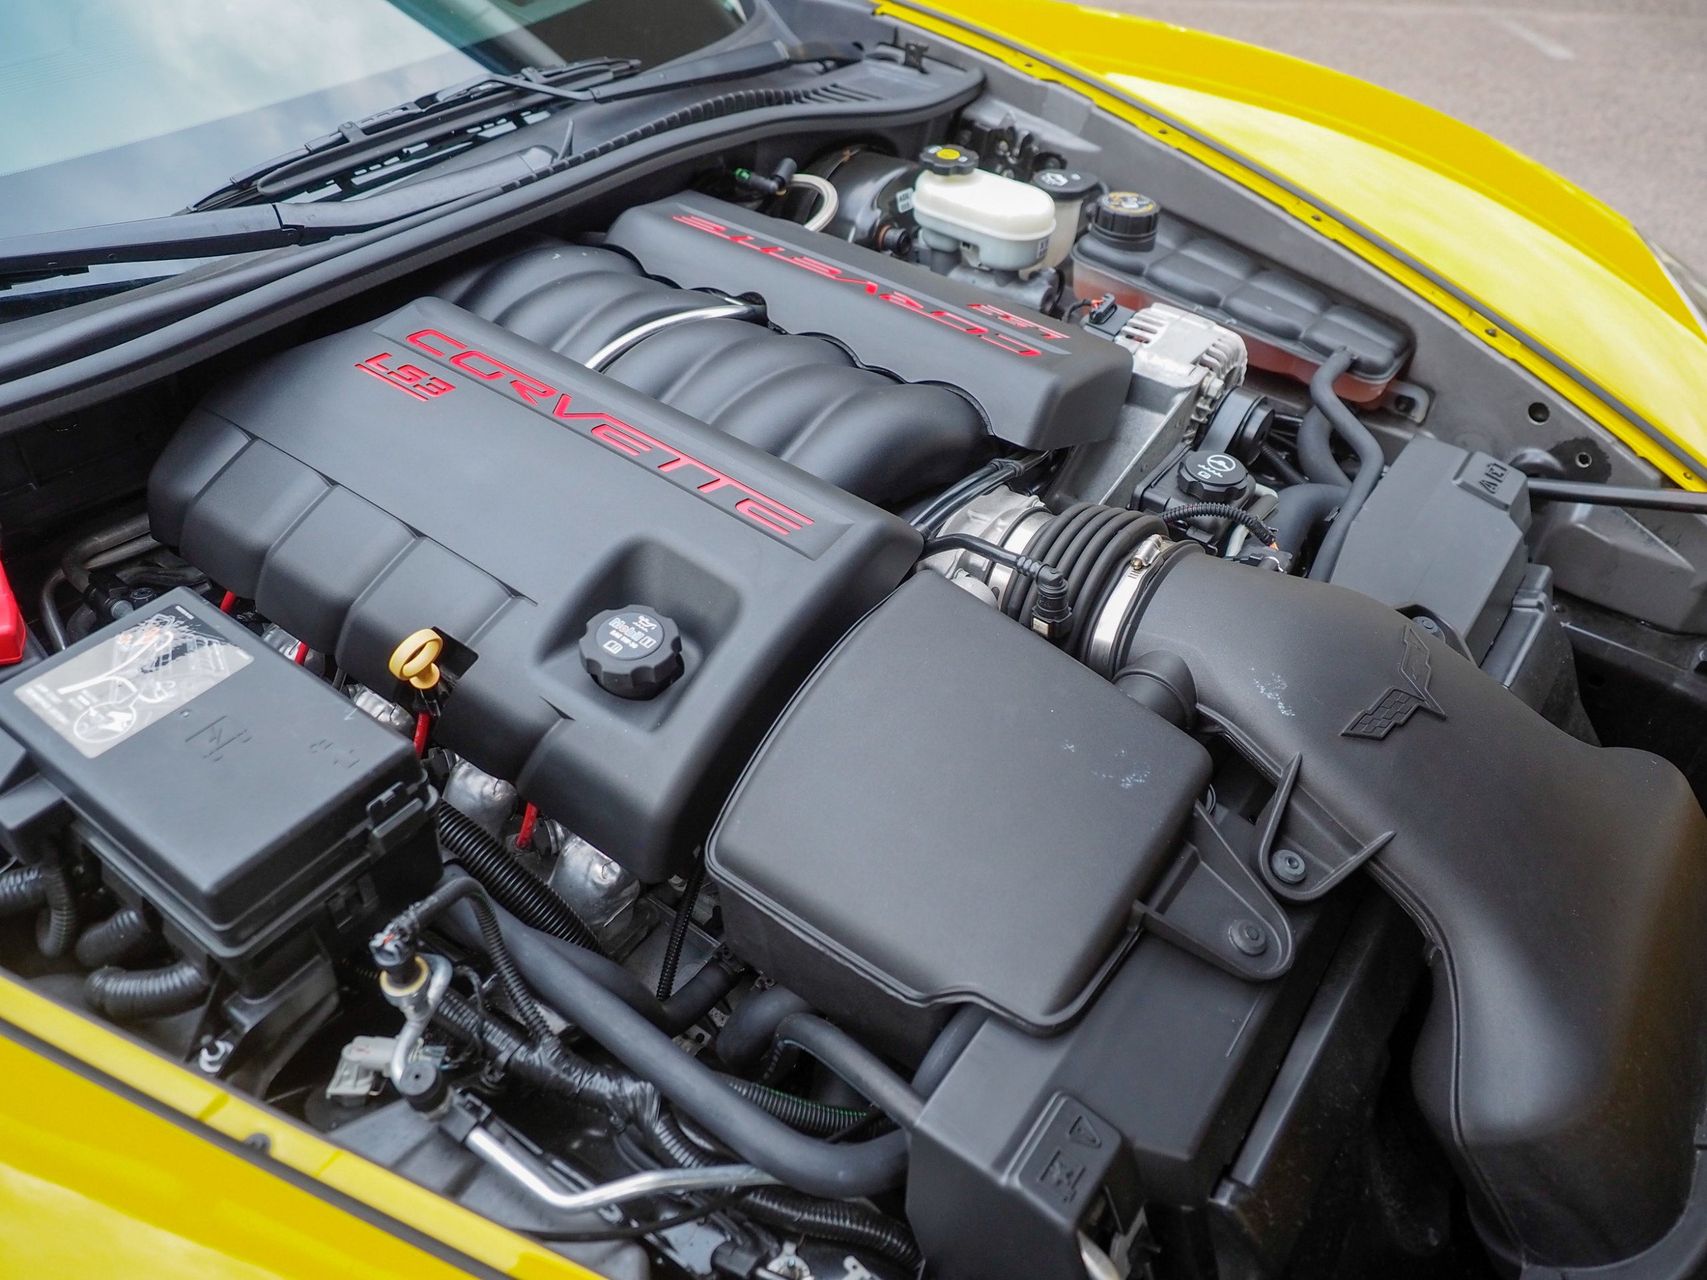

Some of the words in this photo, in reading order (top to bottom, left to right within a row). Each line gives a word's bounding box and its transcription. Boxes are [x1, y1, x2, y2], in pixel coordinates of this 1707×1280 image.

[672, 215, 1043, 358] CORVETTE
[356, 352, 457, 401] LS3
[405, 328, 814, 535] CORVETTE
